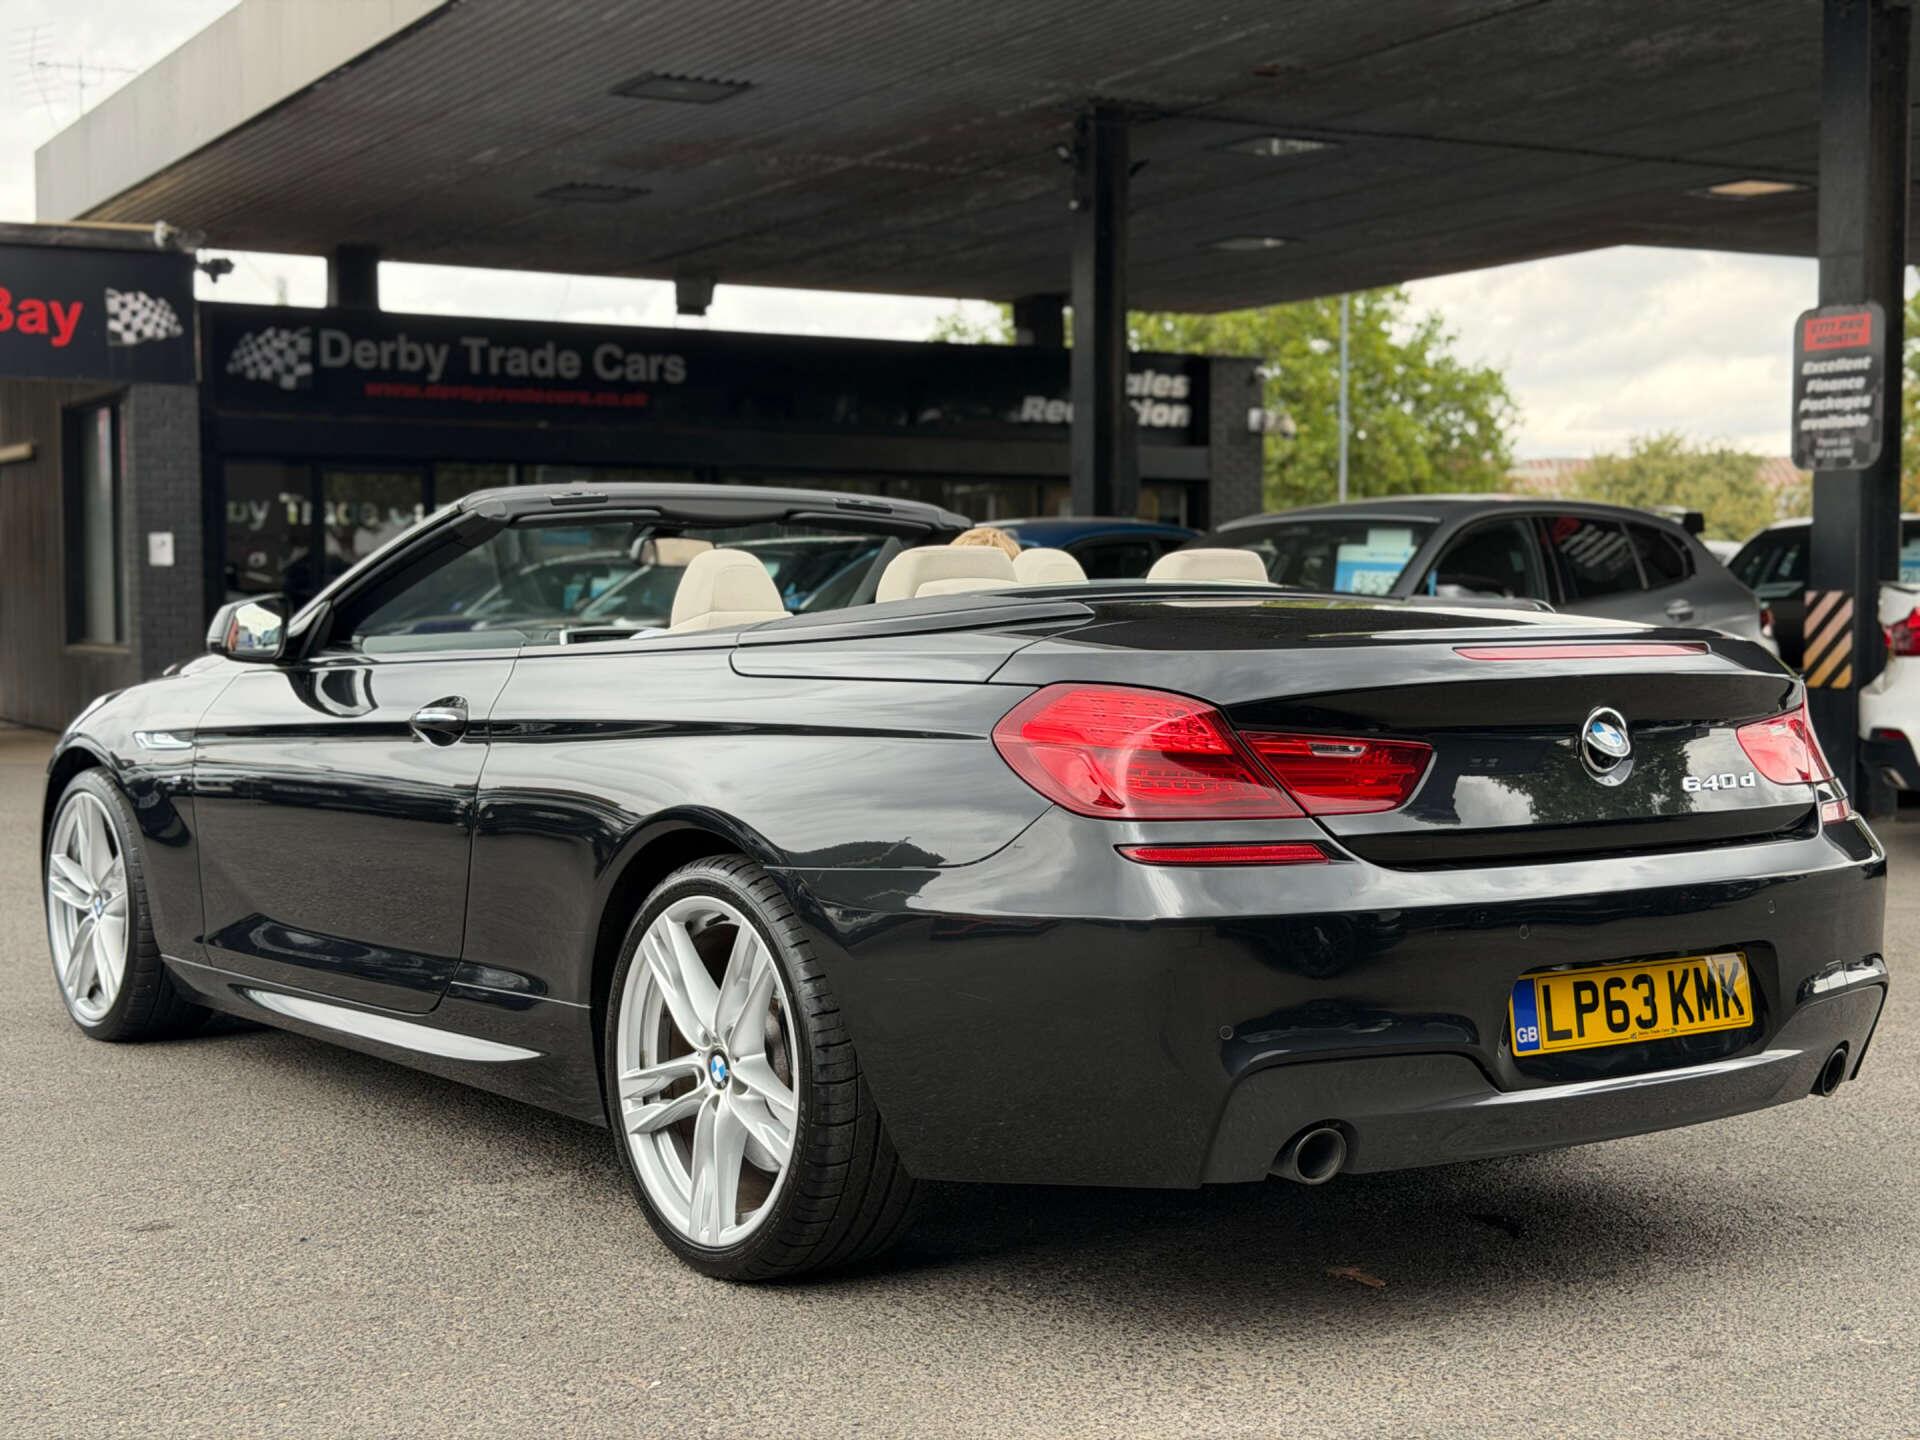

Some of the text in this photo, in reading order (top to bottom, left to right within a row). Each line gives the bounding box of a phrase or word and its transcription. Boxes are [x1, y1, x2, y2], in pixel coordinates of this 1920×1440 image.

[319, 328, 687, 384] Derby Trade Cars
[1125, 370, 1190, 399] ales
[1682, 772, 1757, 793] 640d
[1542, 961, 1745, 1042] LP63 KMK
[1516, 1026, 1538, 1043] GB
